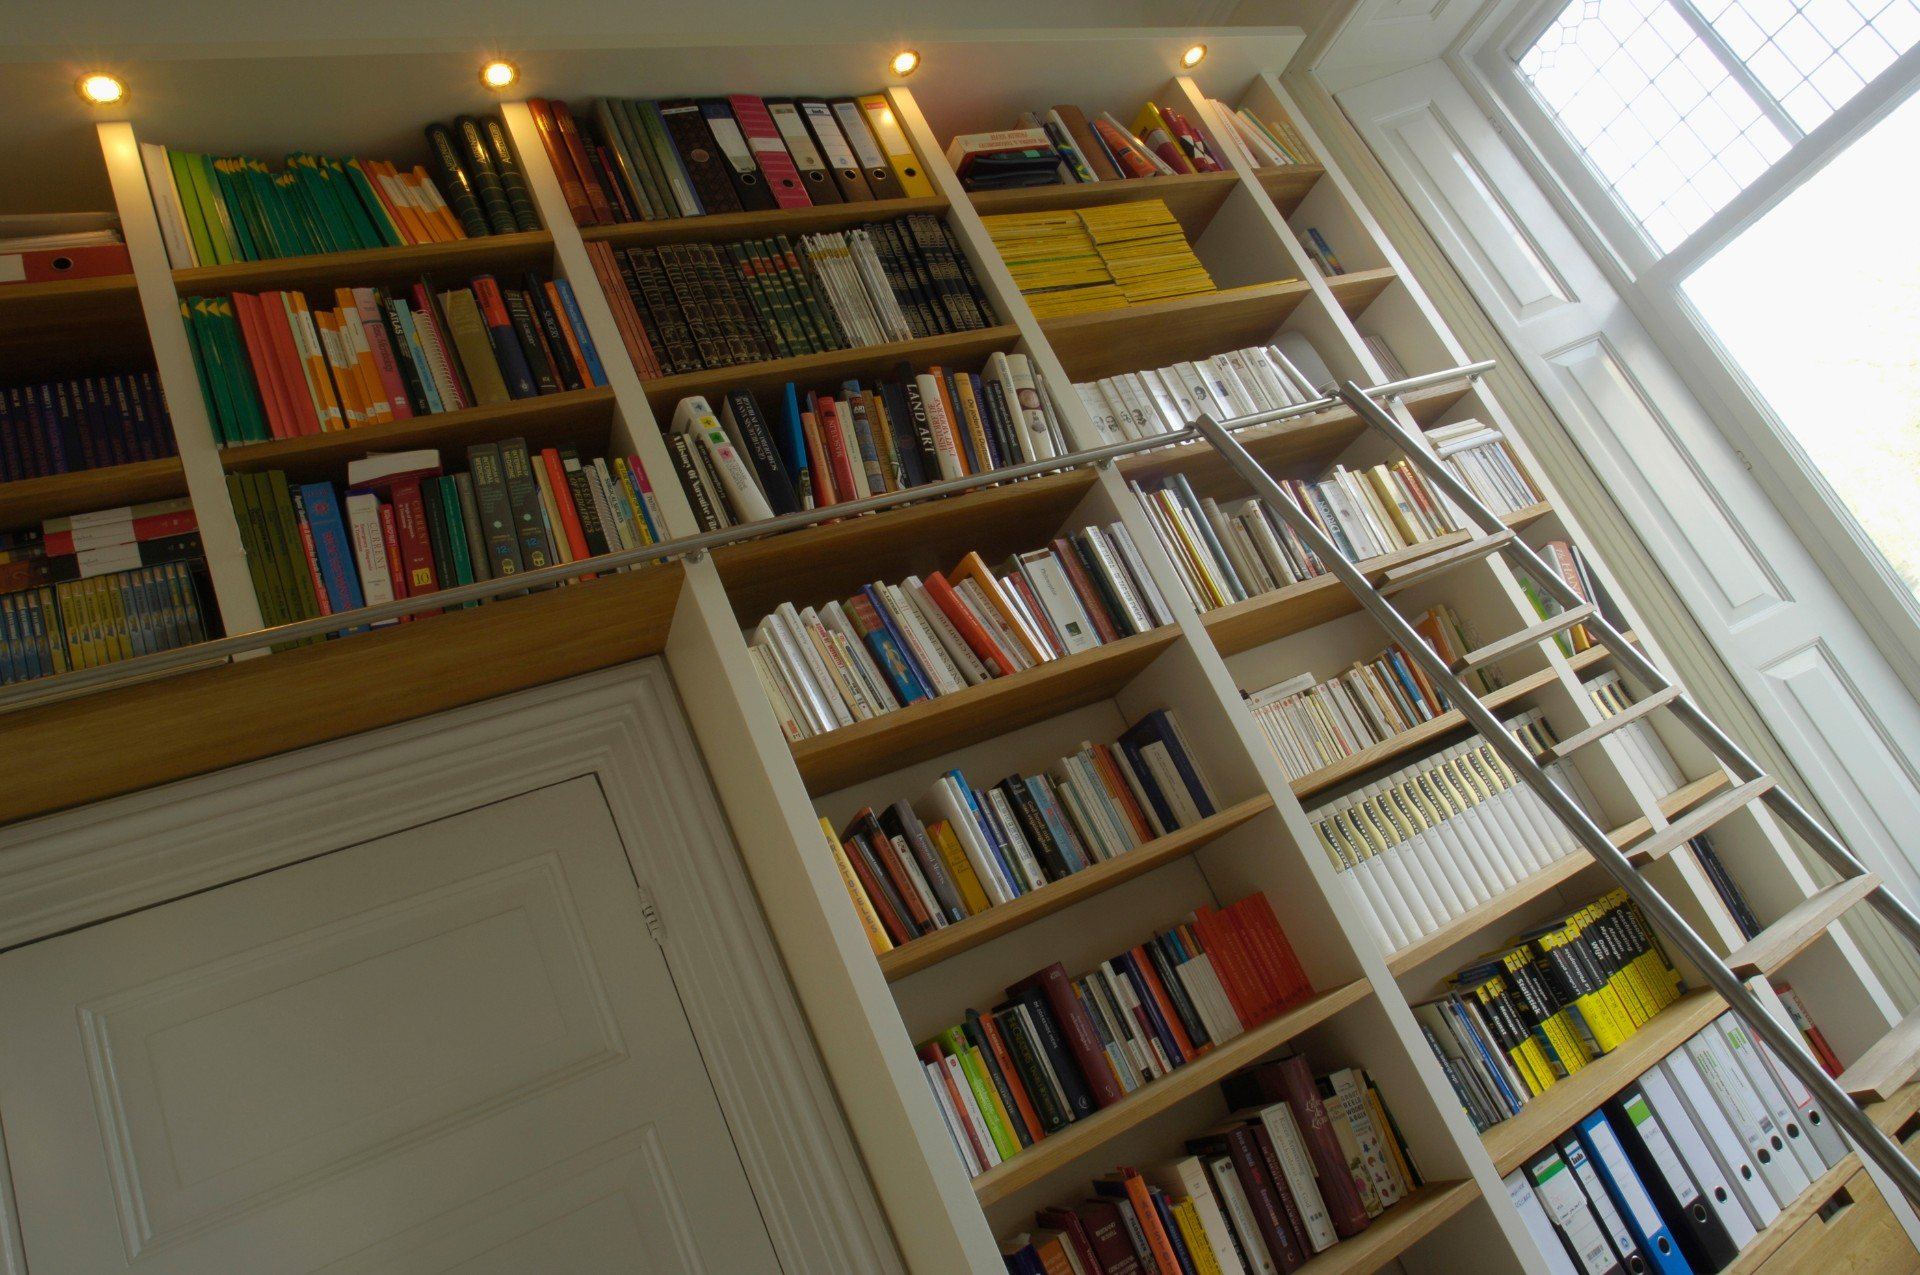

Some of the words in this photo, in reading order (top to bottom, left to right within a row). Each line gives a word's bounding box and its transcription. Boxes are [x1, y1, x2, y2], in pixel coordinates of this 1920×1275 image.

[388, 310, 402, 335] ATLAS
[966, 397, 974, 406] De
[906, 381, 926, 423] LAND
[918, 424, 937, 457] ART
[930, 414, 947, 452] HISTOIRE
[967, 407, 981, 430] joden
[474, 457, 485, 486] MEDICINE
[482, 455, 493, 484] INTERNAL
[503, 450, 514, 479] MEDICINE
[511, 449, 522, 477] INTERNAL
[674, 440, 692, 469] History
[691, 479, 712, 516] Narrative
[574, 488, 593, 534] PEDIATRICS
[577, 476, 601, 532] ESSENTIALS
[604, 477, 616, 501] SURGICAL
[612, 502, 624, 523] SECRETS
[1318, 499, 1340, 534] DRUON
[368, 521, 386, 570] CURRENT
[917, 617, 937, 644] LIVRE
[1026, 799, 1036, 811] God
[915, 833, 935, 863] Desmond
[825, 836, 878, 934] ARISTOTELES
[1598, 924, 1622, 961] Mythologie
[1610, 915, 1633, 952] Marketing
[1615, 908, 1643, 953] Geschiedenis
[1625, 910, 1646, 942] Filosofie
[1589, 940, 1605, 960] Wijn
[1597, 938, 1610, 956] Duits
[1562, 947, 1587, 984] Philosophie
[1515, 977, 1541, 1015] Statistiek
[1492, 1014, 1507, 1036] Kunst
[1499, 1004, 1518, 1035] Managen
[1500, 992, 1517, 1018] Klassieke
[1515, 1018, 1528, 1038] muziek
